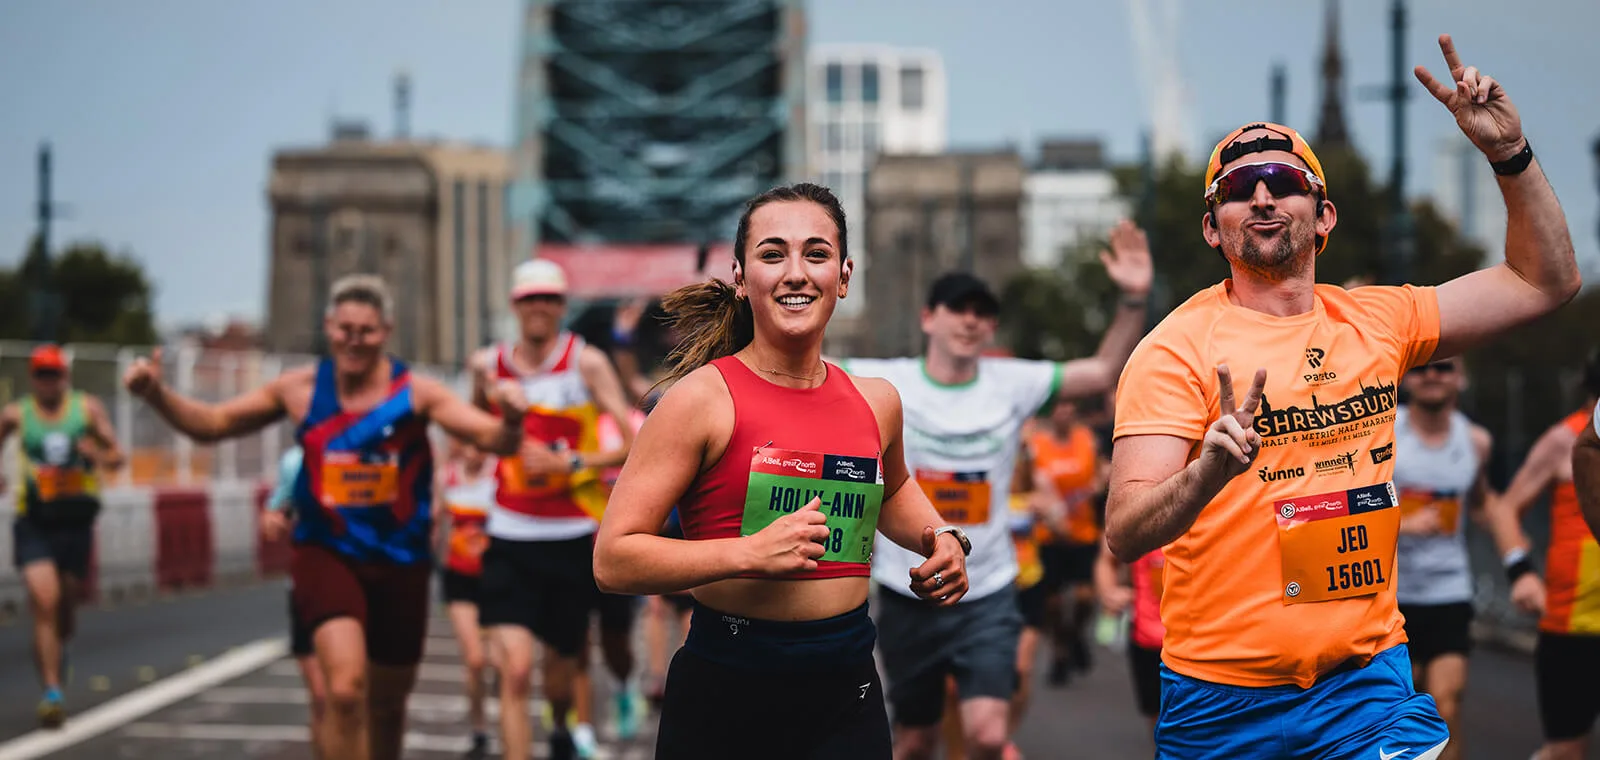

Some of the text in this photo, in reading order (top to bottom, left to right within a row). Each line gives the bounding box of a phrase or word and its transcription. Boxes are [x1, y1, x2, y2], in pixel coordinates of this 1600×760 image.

[1257, 390, 1397, 437] SHREWSBURY
[1261, 437, 1289, 448] HALF
[1292, 435, 1298, 443] &
[1301, 430, 1335, 442] METRIC
[1338, 423, 1360, 435] HALF
[1314, 456, 1346, 469] winner
[1337, 524, 1369, 554] JED
[1326, 558, 1386, 592] 15601
